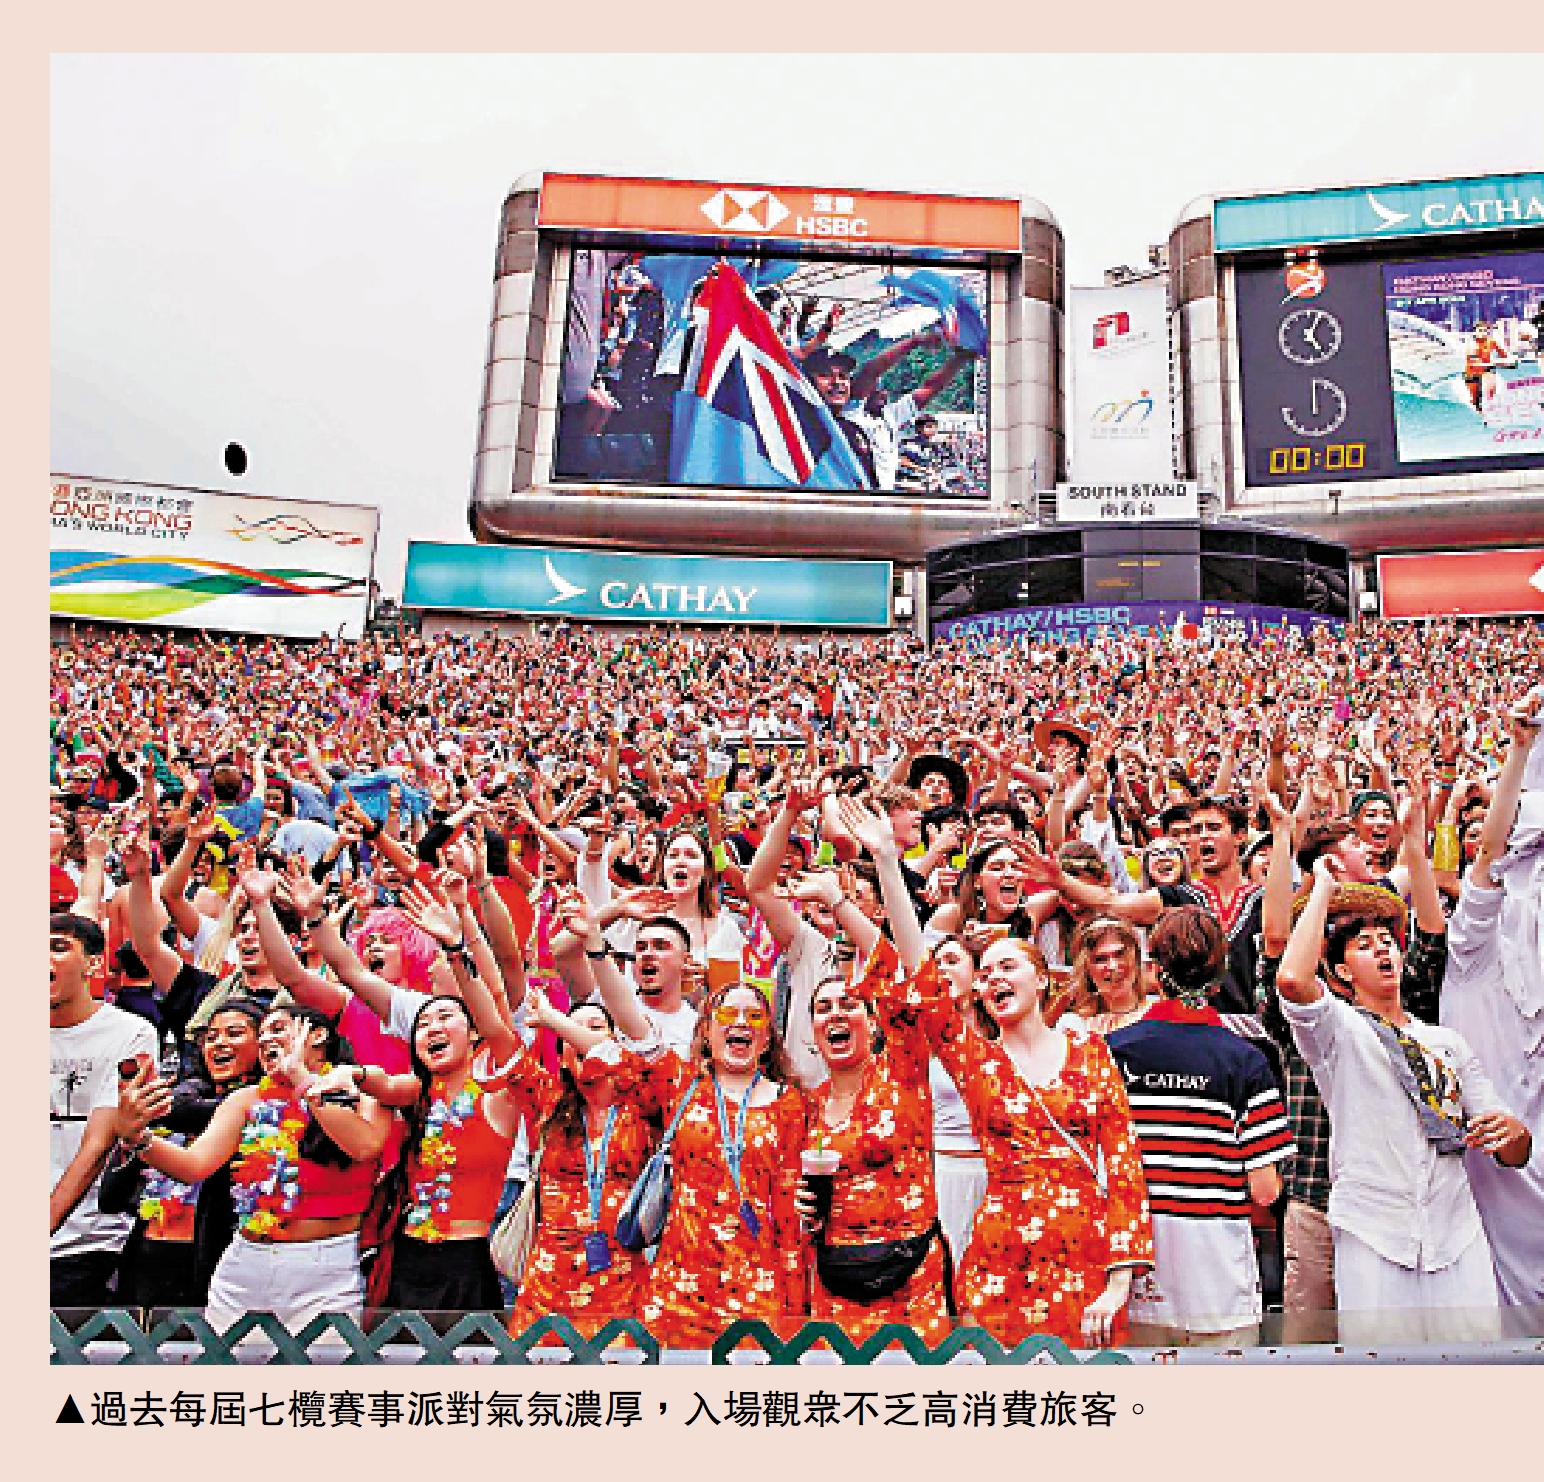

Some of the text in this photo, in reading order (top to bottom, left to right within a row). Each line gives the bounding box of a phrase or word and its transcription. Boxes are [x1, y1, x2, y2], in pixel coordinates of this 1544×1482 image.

[796, 216, 868, 237] HSBC
[1269, 444, 1367, 474] 00:00
[1069, 484, 1187, 499] SOUTH STAND
[114, 507, 192, 530] KONG
[600, 581, 758, 614] CATHAY
[1143, 1073, 1211, 1090] CATHAY
